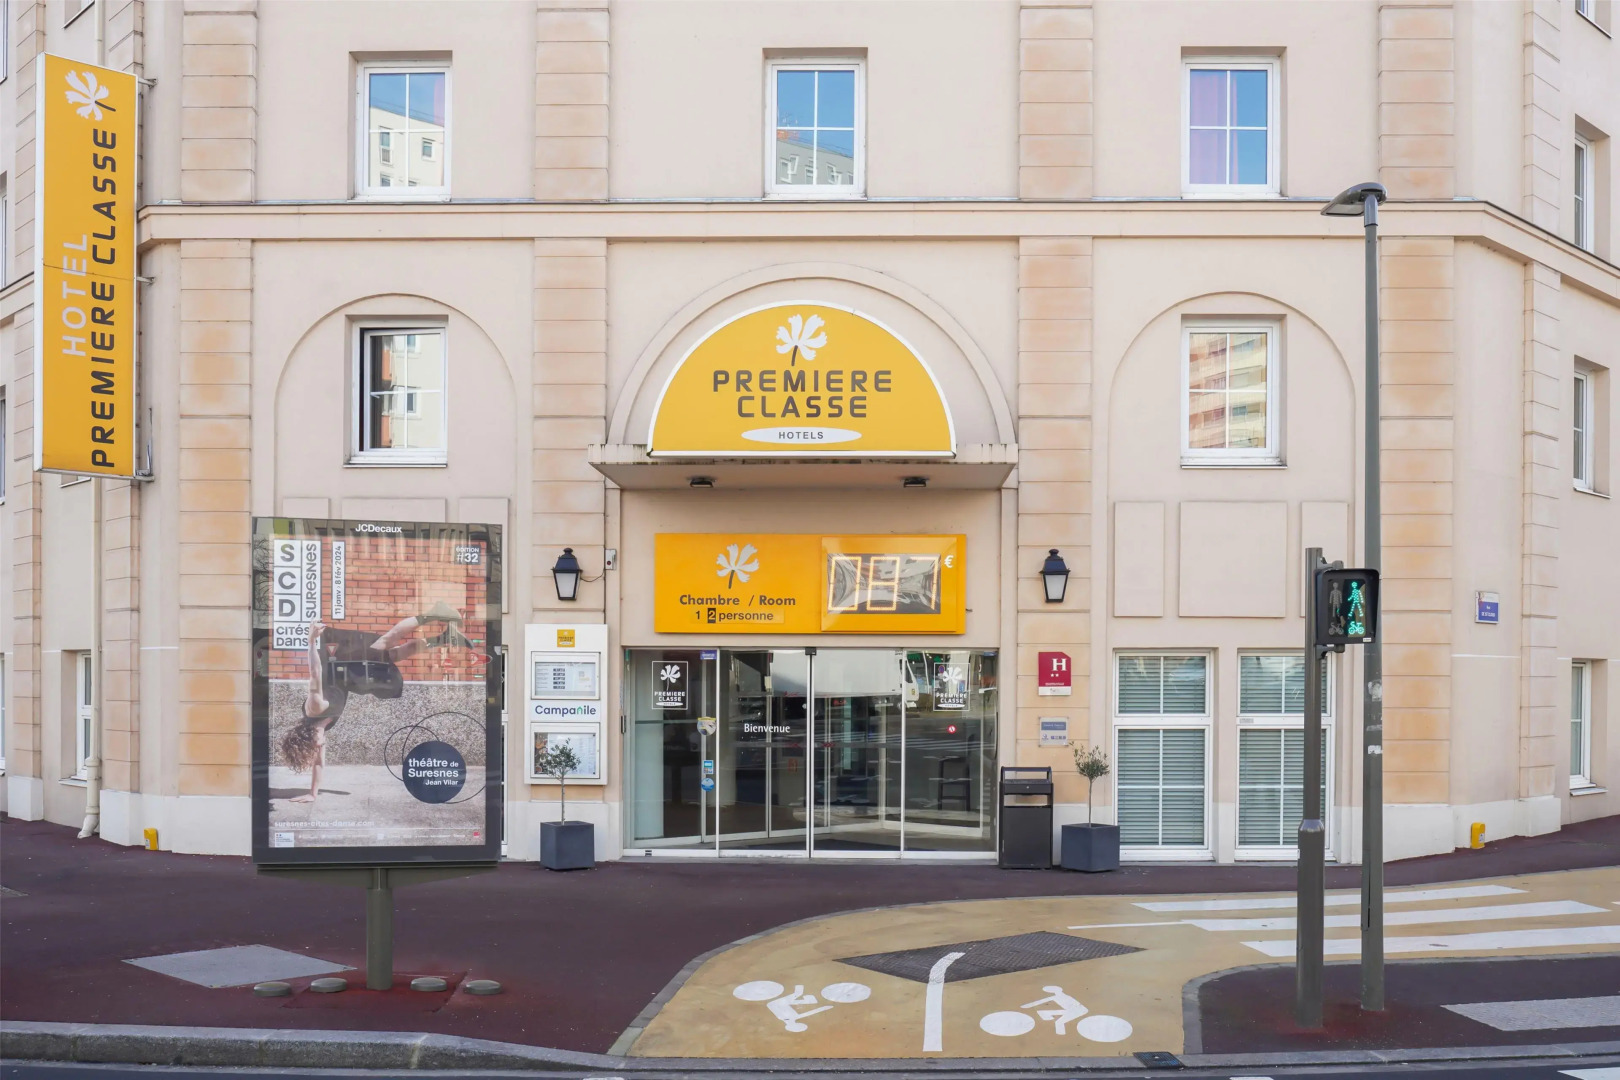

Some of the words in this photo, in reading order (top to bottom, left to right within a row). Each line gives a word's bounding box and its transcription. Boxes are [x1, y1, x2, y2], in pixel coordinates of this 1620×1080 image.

[92, 128, 116, 265] CLASSE
[62, 233, 87, 357] HOTEL
[91, 281, 115, 468] PREMIERE
[713, 369, 892, 392] PREMIERE
[737, 395, 867, 418] CLASSE
[778, 431, 824, 440] HOTELS
[355, 523, 402, 533] JCDecaux
[457, 553, 479, 563] #32
[943, 554, 955, 569] €
[335, 590, 343, 607] janv
[679, 594, 740, 606] Chambre
[758, 594, 796, 606] Room
[695, 611, 701, 620] 1
[708, 610, 716, 621] 2
[718, 612, 774, 624] personne
[1052, 658, 1067, 672] H
[534, 704, 597, 718] Campanile
[743, 723, 791, 734] Bienvenue
[408, 757, 448, 768] théâtre
[407, 768, 459, 778] Suresnes
